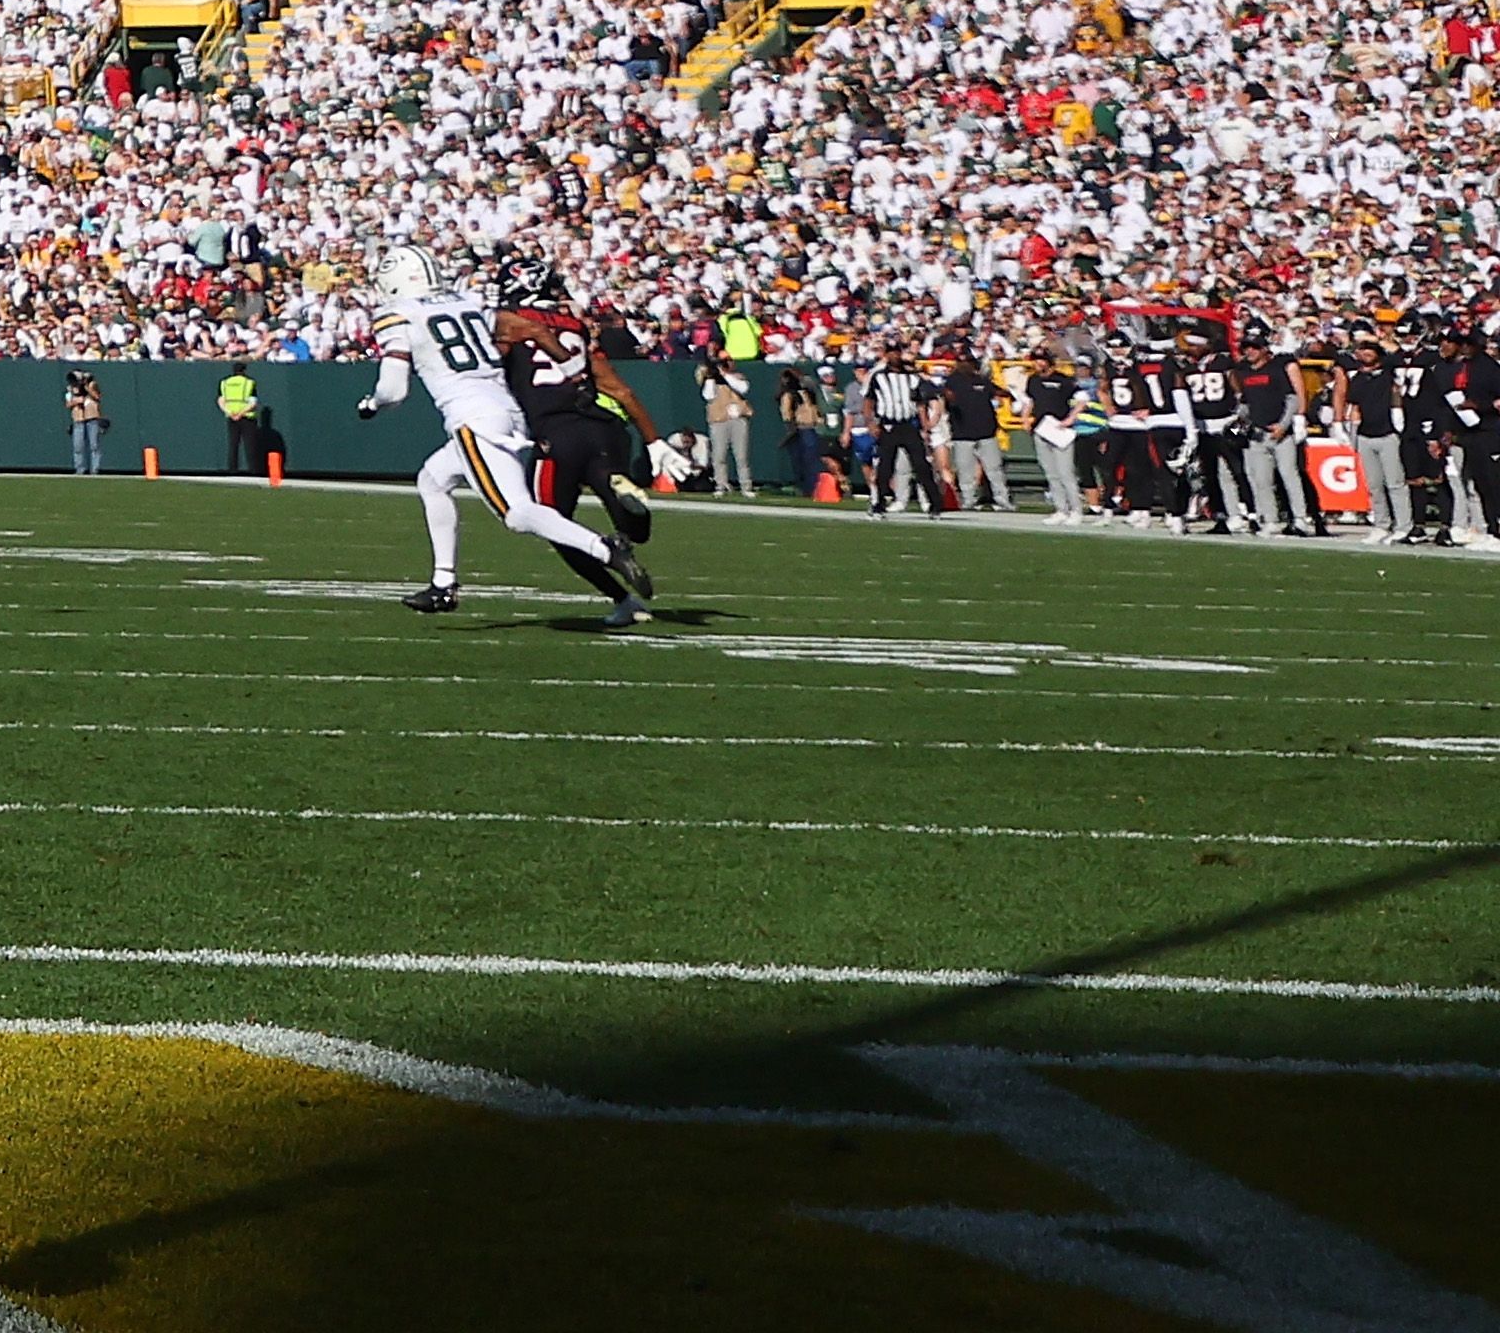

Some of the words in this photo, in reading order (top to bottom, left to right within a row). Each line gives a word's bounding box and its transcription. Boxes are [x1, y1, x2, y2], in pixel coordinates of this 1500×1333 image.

[426, 310, 503, 373] 80
[1185, 371, 1228, 404] 28
[1319, 454, 1359, 494] G
